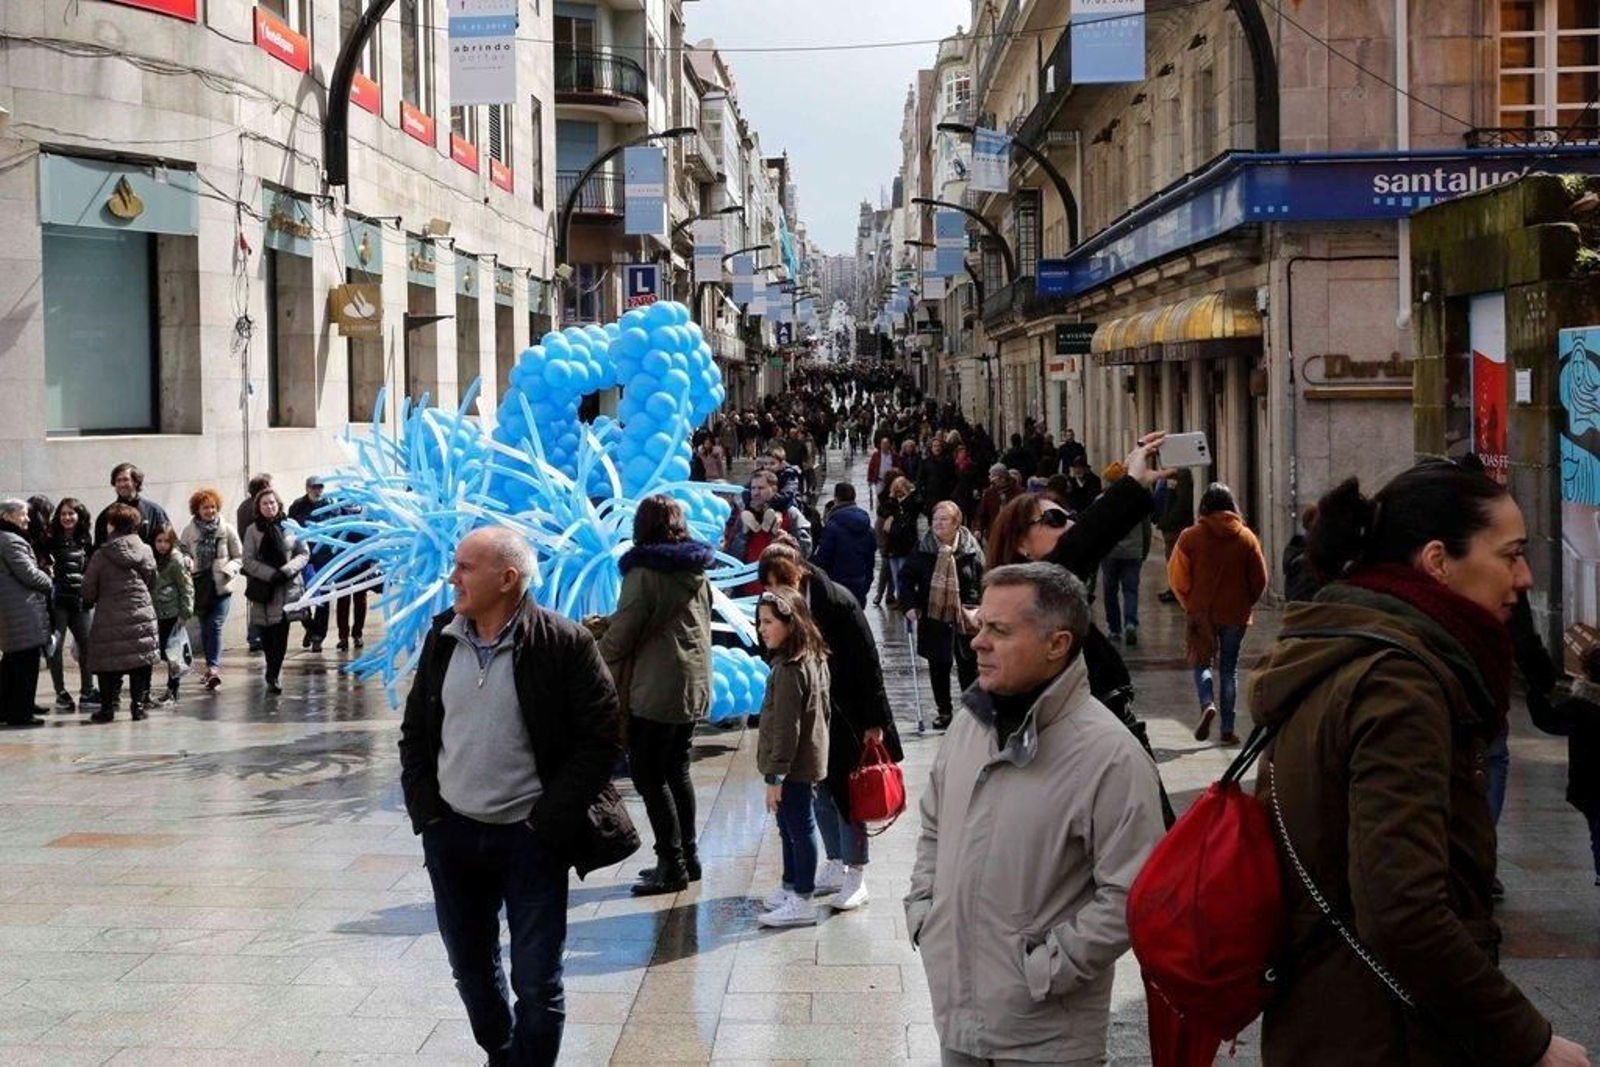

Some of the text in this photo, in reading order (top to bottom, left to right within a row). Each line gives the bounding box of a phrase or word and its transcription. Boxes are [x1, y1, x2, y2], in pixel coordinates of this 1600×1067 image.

[454, 43, 511, 53] abrindo
[1373, 166, 1550, 193] santaluc
[628, 294, 657, 307] FARO
